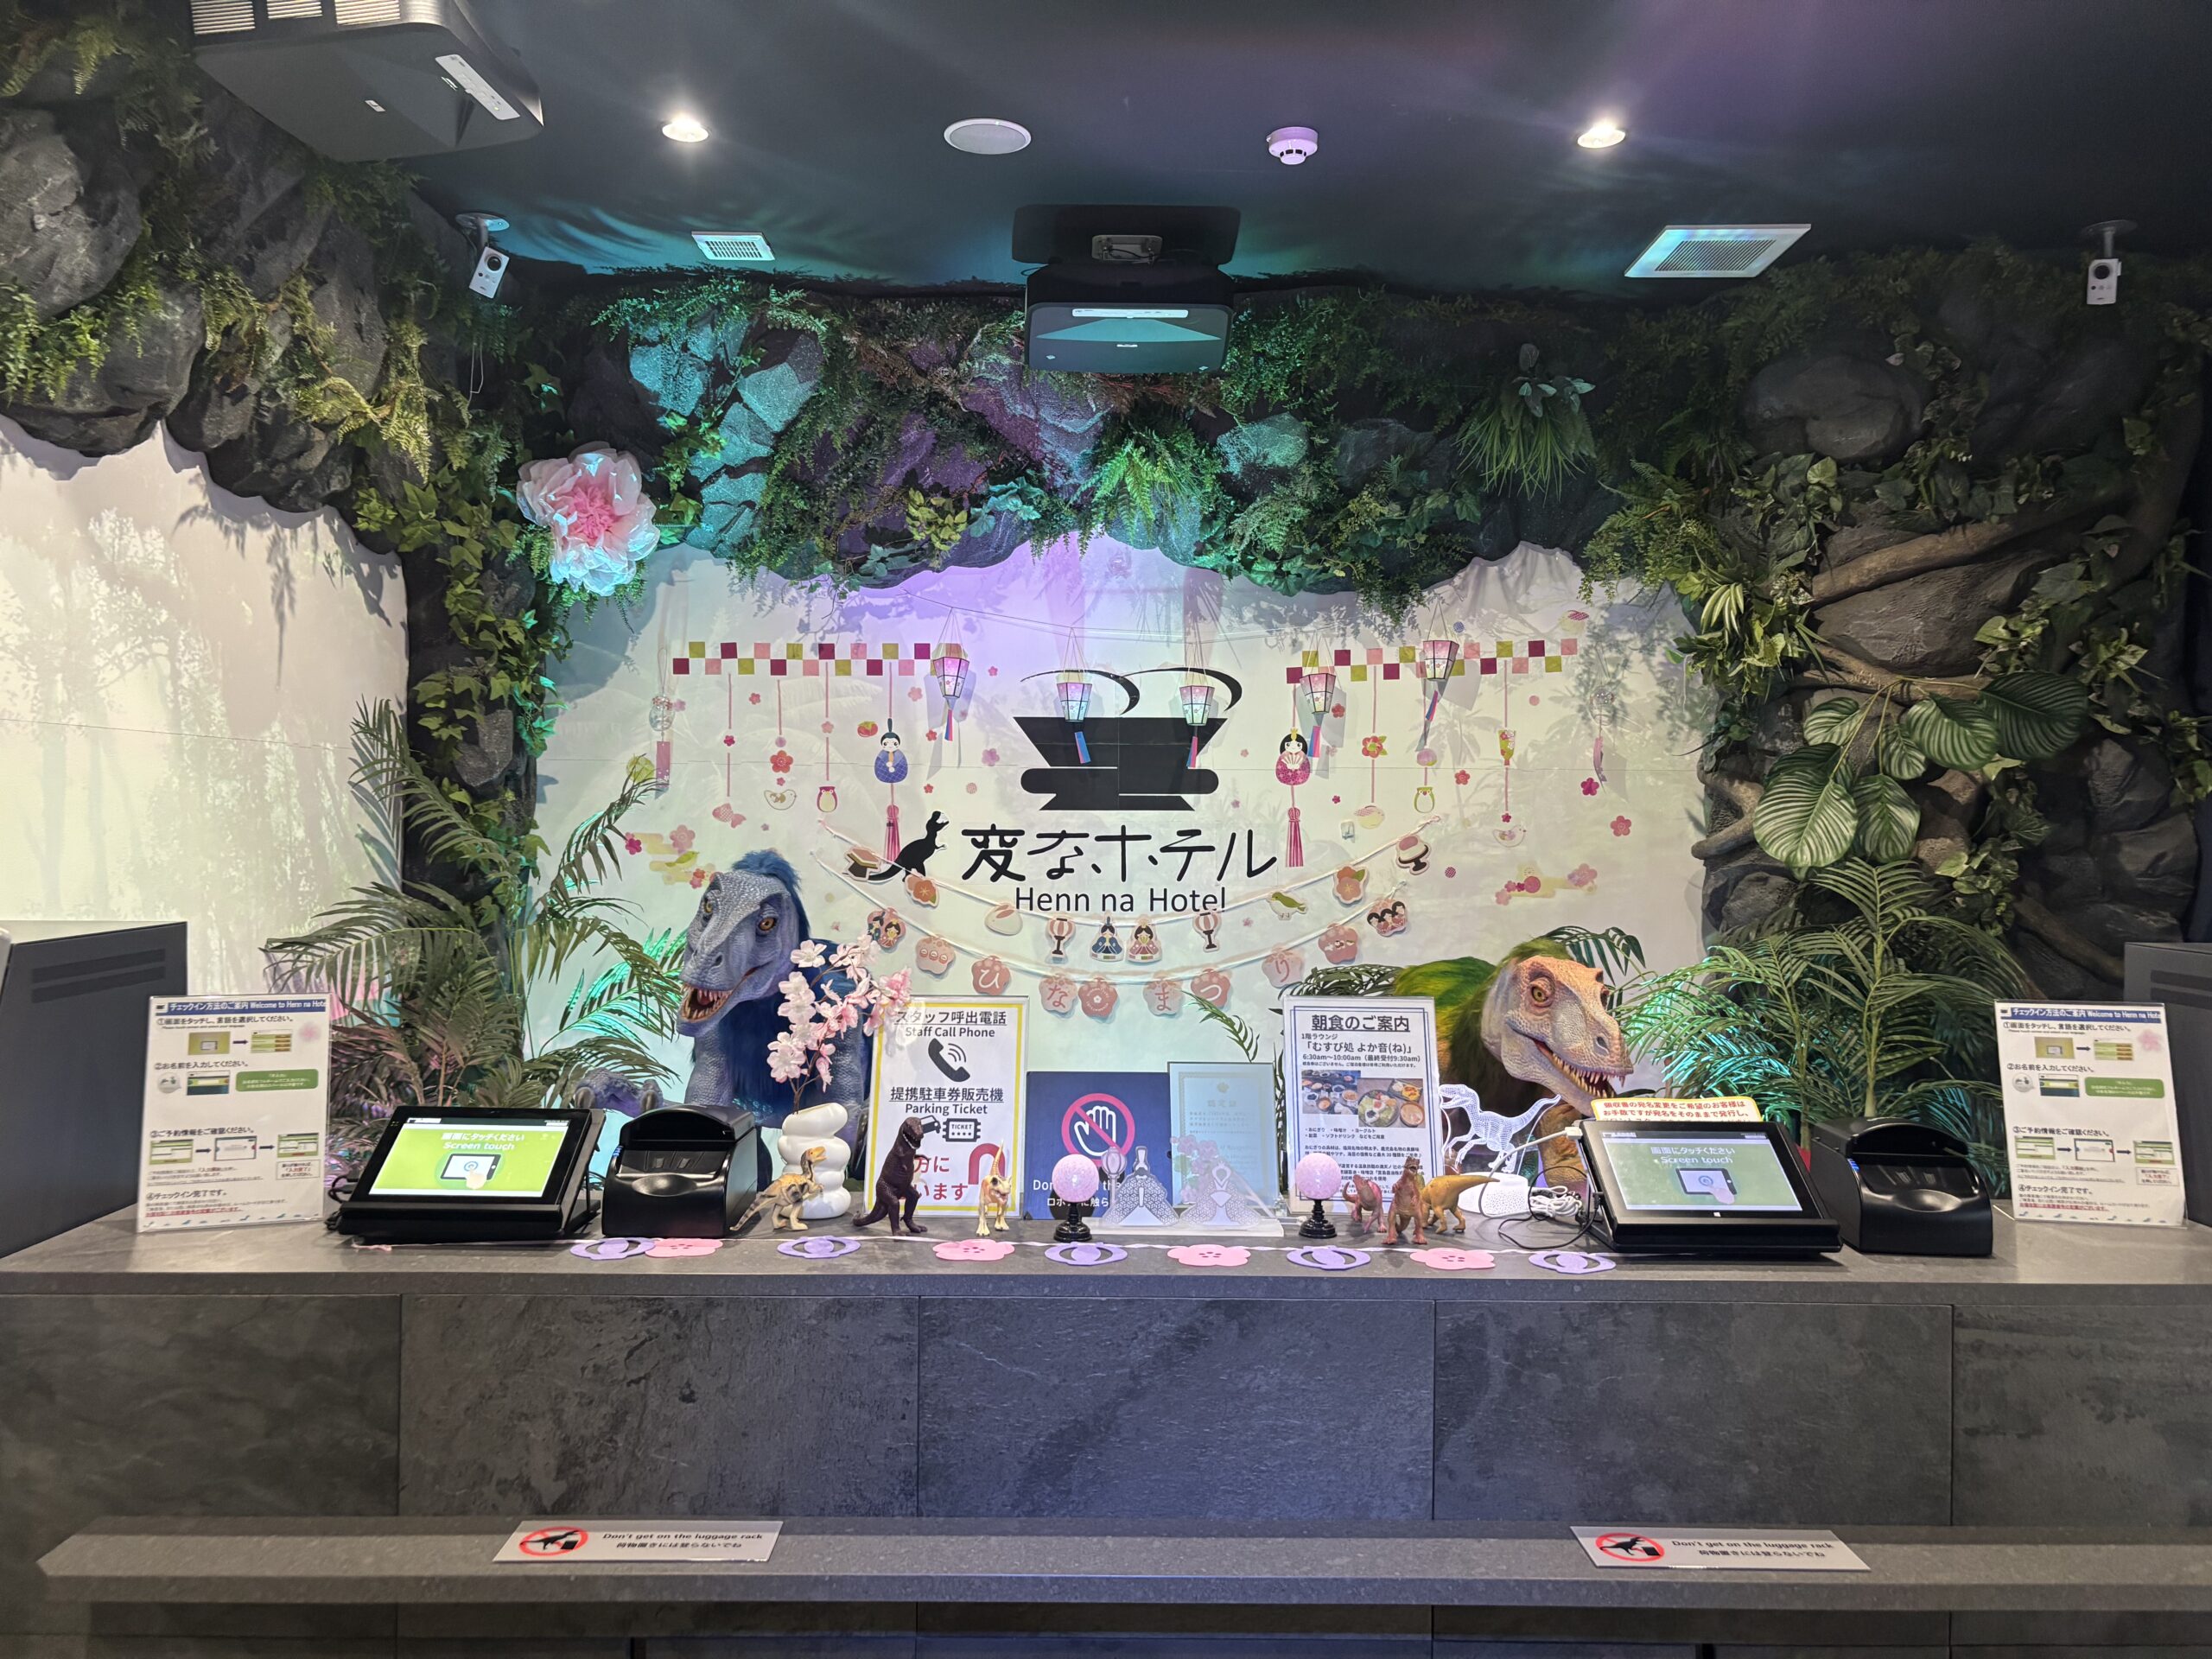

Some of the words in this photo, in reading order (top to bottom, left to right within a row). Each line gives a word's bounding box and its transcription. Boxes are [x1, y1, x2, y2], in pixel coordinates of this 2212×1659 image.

[961, 823, 1278, 883] 変なホテル
[1015, 887, 1090, 912] Henn
[1101, 892, 1135, 912] na
[1149, 887, 1226, 913] Hotel
[895, 1010, 1007, 1024] スタッフ呼出電話
[2087, 1010, 2114, 1019] Welcome
[1311, 1014, 1410, 1031] 朝食のご案内
[906, 1026, 932, 1037] Staff
[935, 1027, 957, 1037] Call
[959, 1027, 995, 1038] Phone
[1307, 1041, 1355, 1052] 「むすび処
[890, 1086, 1004, 1102] 提携駐車券販売機
[905, 1103, 950, 1116] Parking
[952, 1103, 988, 1115] Ticket
[443, 1141, 480, 1150] Screen
[484, 1141, 515, 1151] touch
[1660, 1155, 1699, 1164] Screen
[1701, 1155, 1734, 1164] touch
[695, 1533, 737, 1541] luggage
